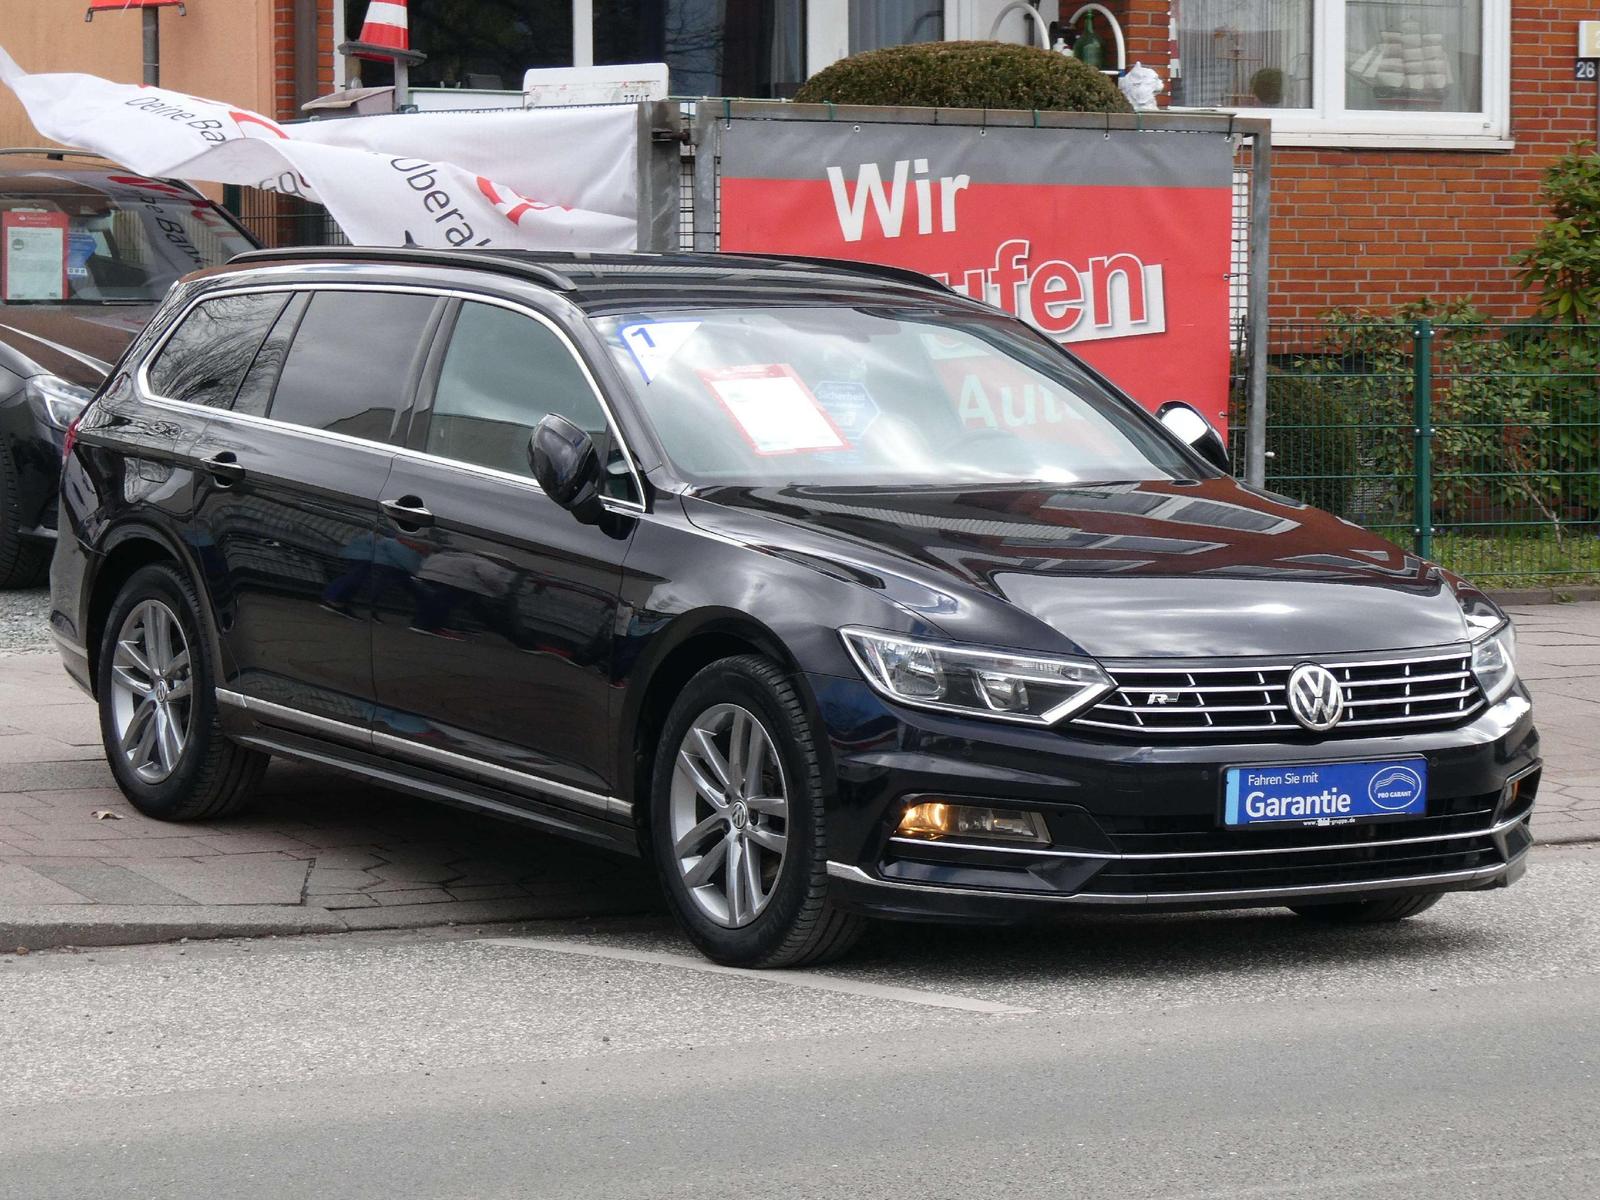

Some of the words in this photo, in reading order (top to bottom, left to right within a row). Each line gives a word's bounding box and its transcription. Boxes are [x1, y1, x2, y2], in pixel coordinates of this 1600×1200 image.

[1576, 61, 1595, 78] 26
[125, 96, 195, 121] Deine
[185, 118, 226, 147] Ba
[826, 158, 971, 242] Wir
[630, 327, 656, 348] 1
[957, 373, 1085, 429] Aut
[1248, 773, 1282, 786] Fahren
[1284, 772, 1300, 784] Sie
[1302, 771, 1319, 783] mit
[1245, 787, 1351, 818] Garantie
[1389, 790, 1412, 798] GARANT
